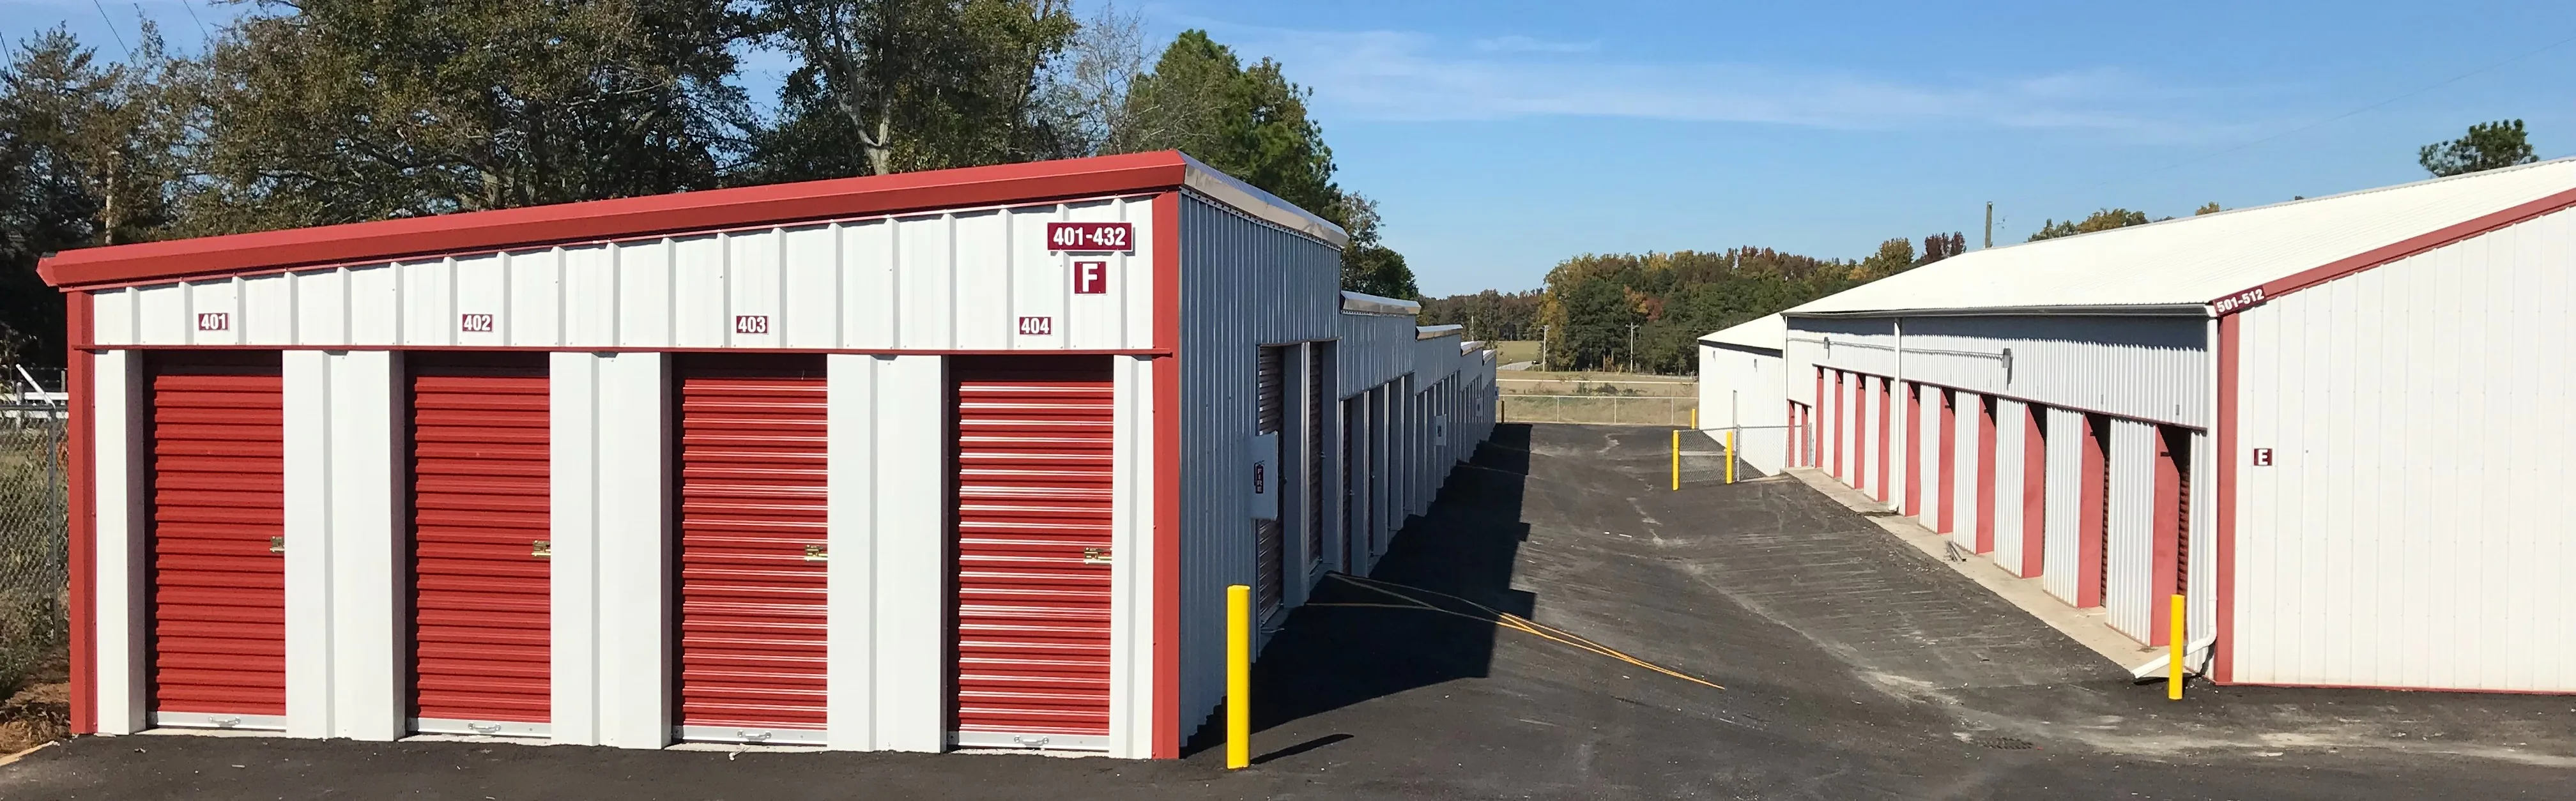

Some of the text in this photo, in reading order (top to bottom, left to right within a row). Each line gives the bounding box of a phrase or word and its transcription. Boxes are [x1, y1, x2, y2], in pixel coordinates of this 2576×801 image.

[1053, 227, 1126, 246] 401-432
[1082, 263, 1098, 292] F
[2216, 289, 2264, 312] 501-512
[201, 314, 226, 330] 401
[464, 315, 491, 331] 402
[738, 316, 766, 333] 403
[1021, 317, 1050, 334] 404
[2258, 449, 2268, 465] E
